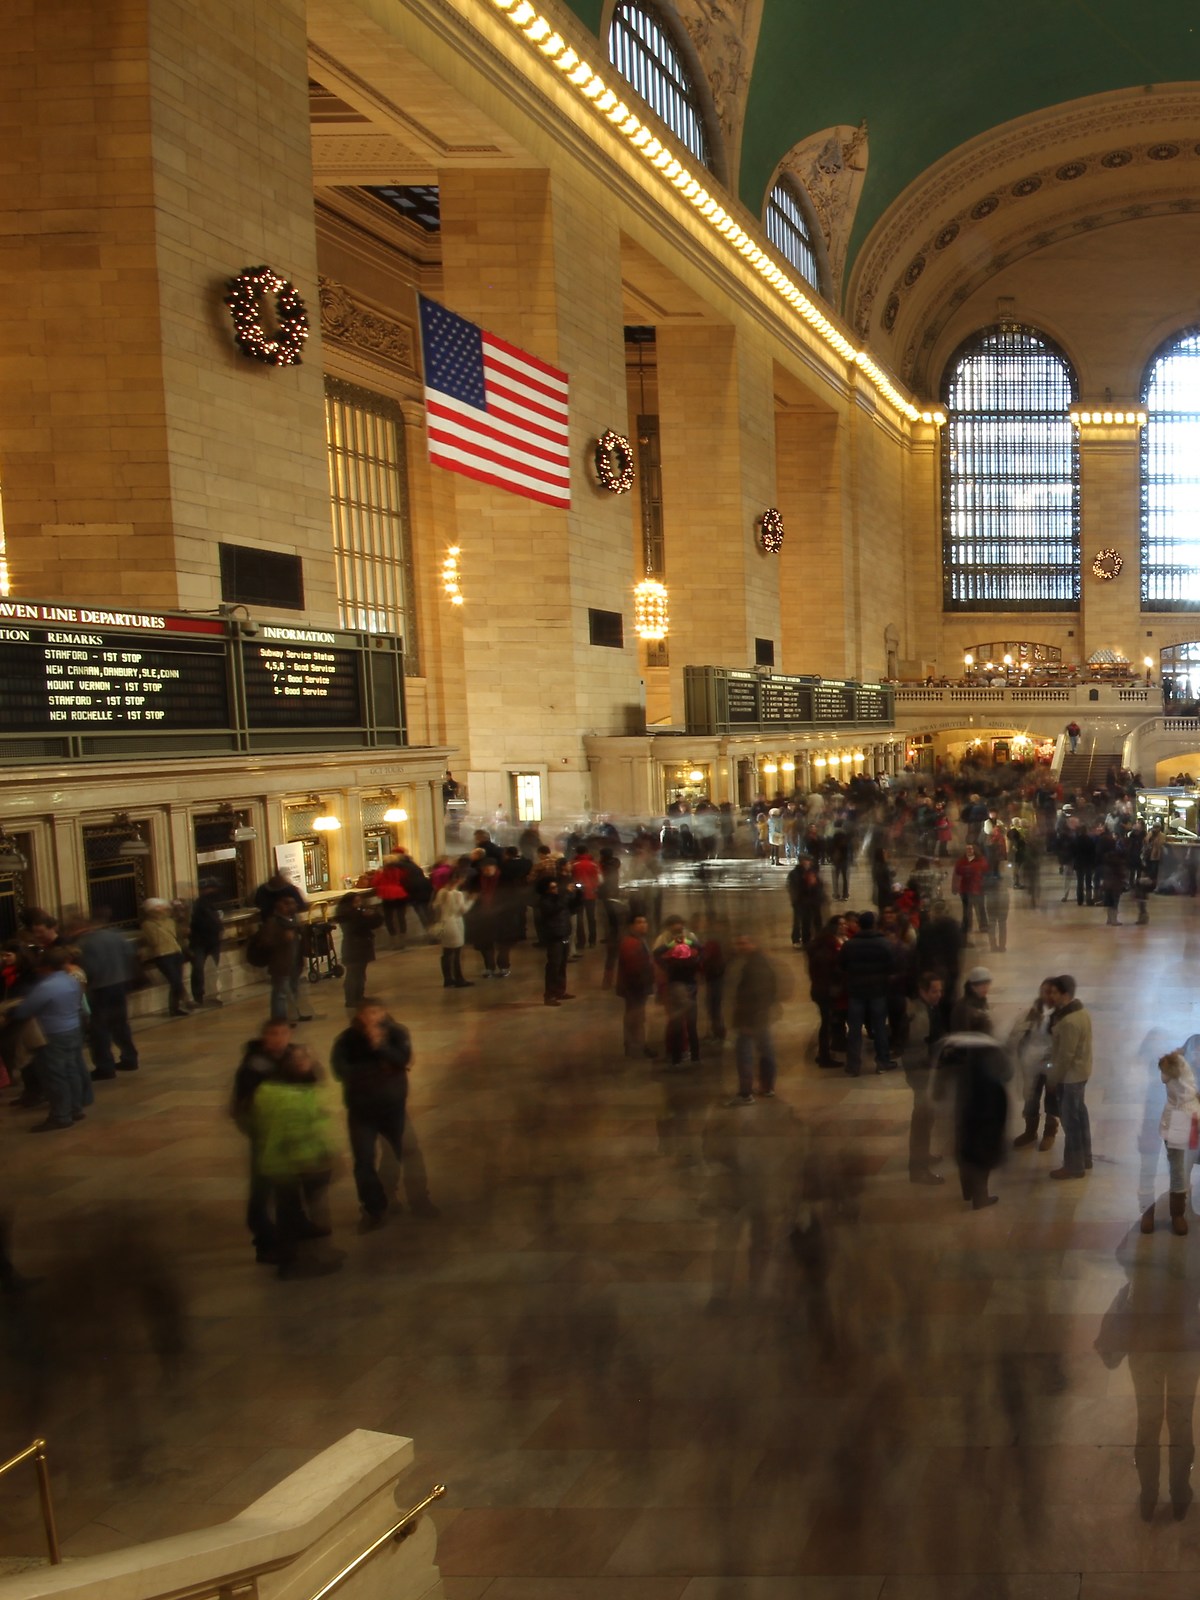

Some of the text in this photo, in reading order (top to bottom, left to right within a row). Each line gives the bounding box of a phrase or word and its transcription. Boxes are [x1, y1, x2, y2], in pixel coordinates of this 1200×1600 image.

[42, 607, 77, 621] LINE
[80, 610, 165, 628] DEPARTURES
[47, 633, 103, 646] REMARKS
[264, 627, 335, 643] INFORMATION
[45, 650, 88, 660] STAMFORD
[103, 652, 118, 662] 1ST
[122, 653, 142, 663] STOP
[260, 648, 335, 662] Subway Service Status
[46, 665, 63, 674] NEW
[265, 661, 285, 671] 4,5,6
[293, 662, 309, 672] Good
[310, 664, 336, 673] Service
[273, 673, 279, 682] 7
[287, 674, 303, 683] Good
[304, 675, 330, 684] Service
[47, 680, 74, 690] MOUNT
[79, 681, 110, 691] VERNON
[125, 682, 139, 691] 1ST
[143, 682, 163, 692] STOP
[284, 686, 300, 695] Good
[302, 687, 328, 696] Service
[49, 695, 91, 705] STAMFORD
[106, 696, 121, 706] 1ST
[125, 696, 145, 706] STOP
[50, 711, 67, 721] NEW
[71, 711, 113, 721] ROCHELLE
[127, 711, 142, 720] 1ST
[145, 711, 165, 720] STOP
